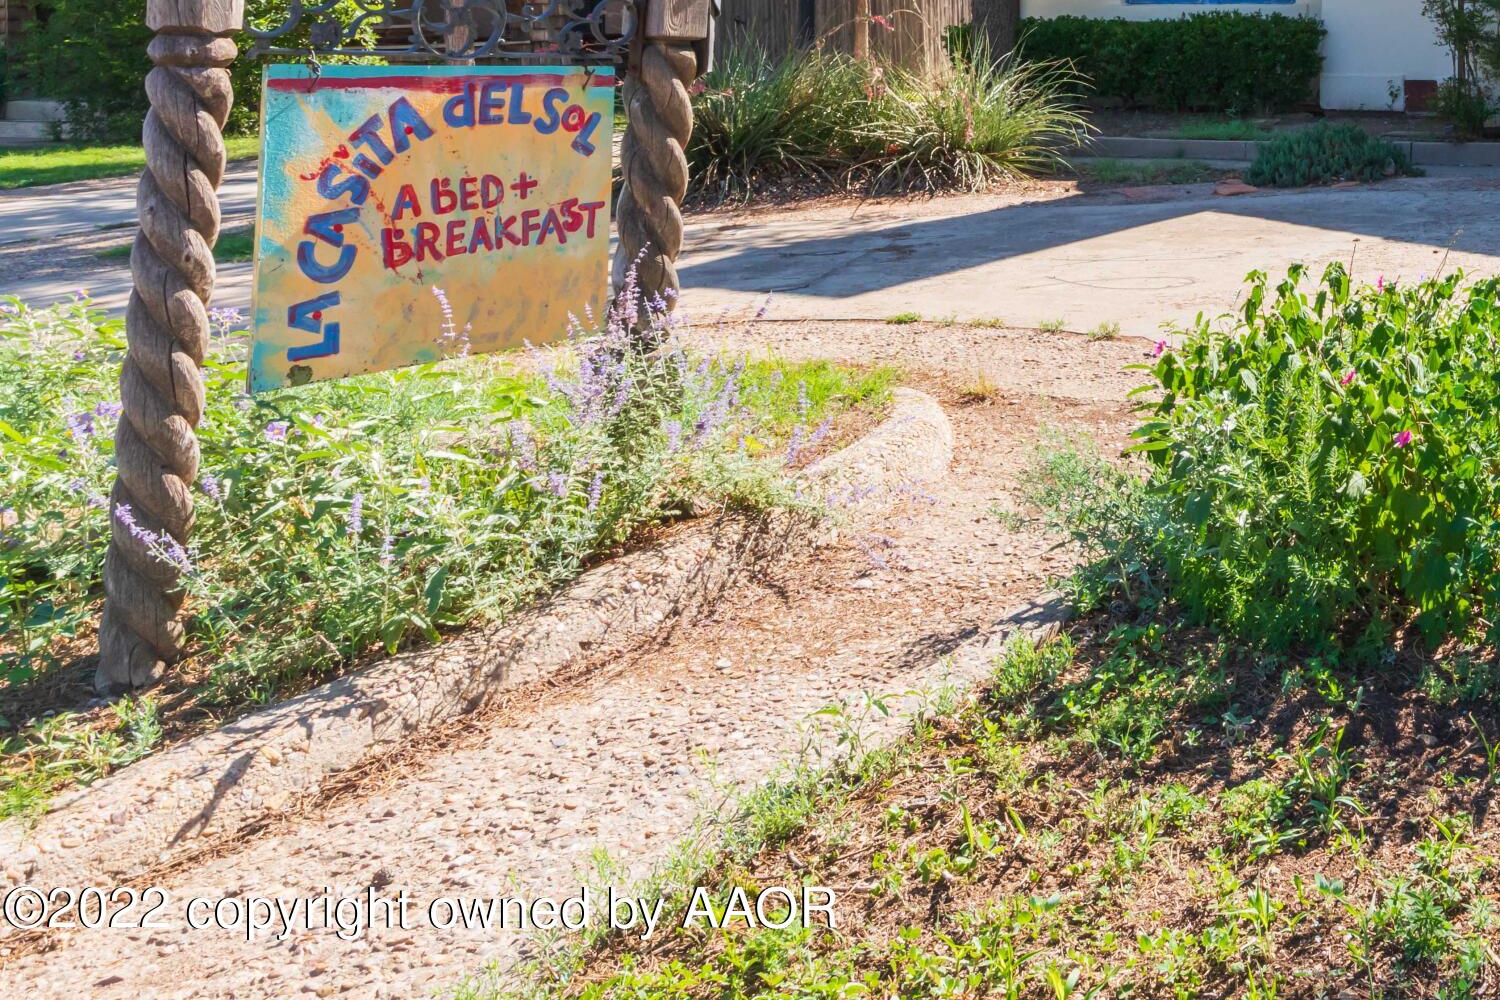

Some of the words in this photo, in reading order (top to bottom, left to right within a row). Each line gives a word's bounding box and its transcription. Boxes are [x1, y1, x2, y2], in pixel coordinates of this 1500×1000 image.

[287, 290, 341, 362] LA
[533, 87, 602, 157] SOL
[391, 184, 422, 220] A
[430, 174, 505, 216] BED
[510, 171, 538, 200] +
[380, 197, 606, 269] BREAKFAST
